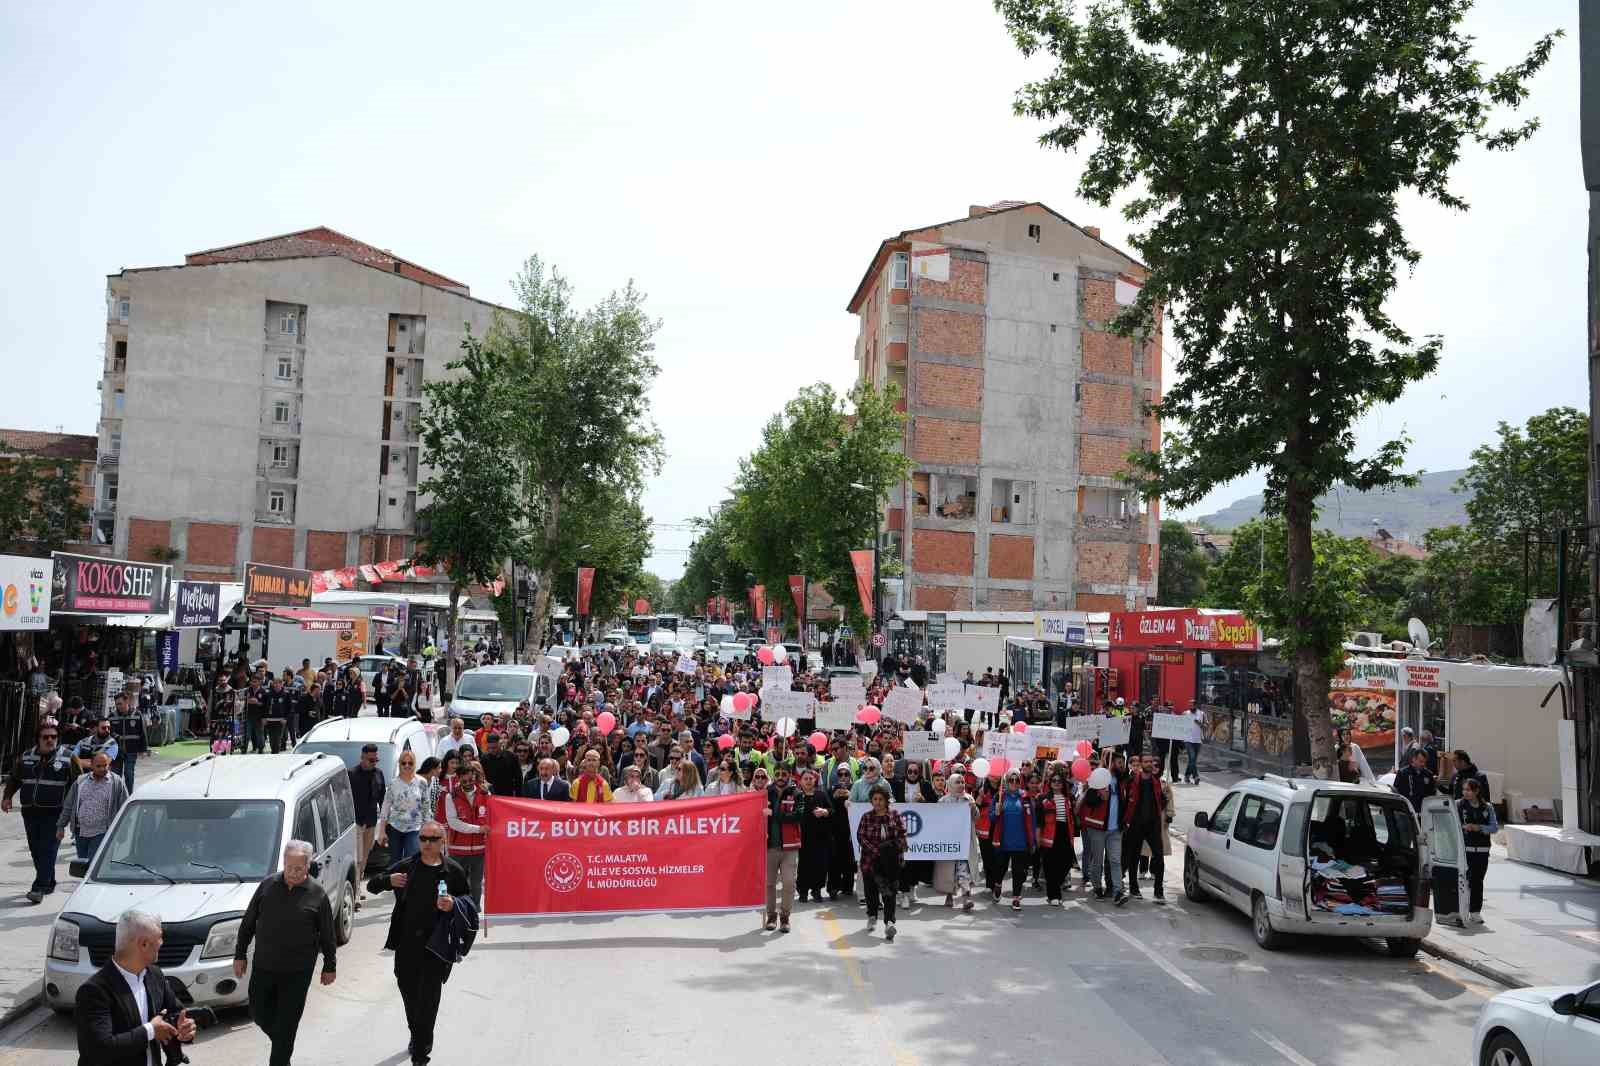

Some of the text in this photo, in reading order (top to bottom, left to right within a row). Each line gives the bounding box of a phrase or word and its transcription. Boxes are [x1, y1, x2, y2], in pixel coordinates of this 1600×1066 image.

[77, 562, 154, 597] KOKOSHE
[253, 576, 286, 593] NUMARA
[1140, 616, 1176, 634] ÖZLEM 44
[875, 635, 884, 644] 50
[507, 814, 741, 839] BİZ, BÜYÜK BİR AİLEYİZ
[905, 841, 961, 853] NİVERSİTESİ
[587, 854, 648, 863] T.C. MALATYA
[587, 864, 705, 876] AİLE VE SOSYAL HİZMELER
[587, 878, 657, 889] İL MÜDÜRLÜĞÜ
